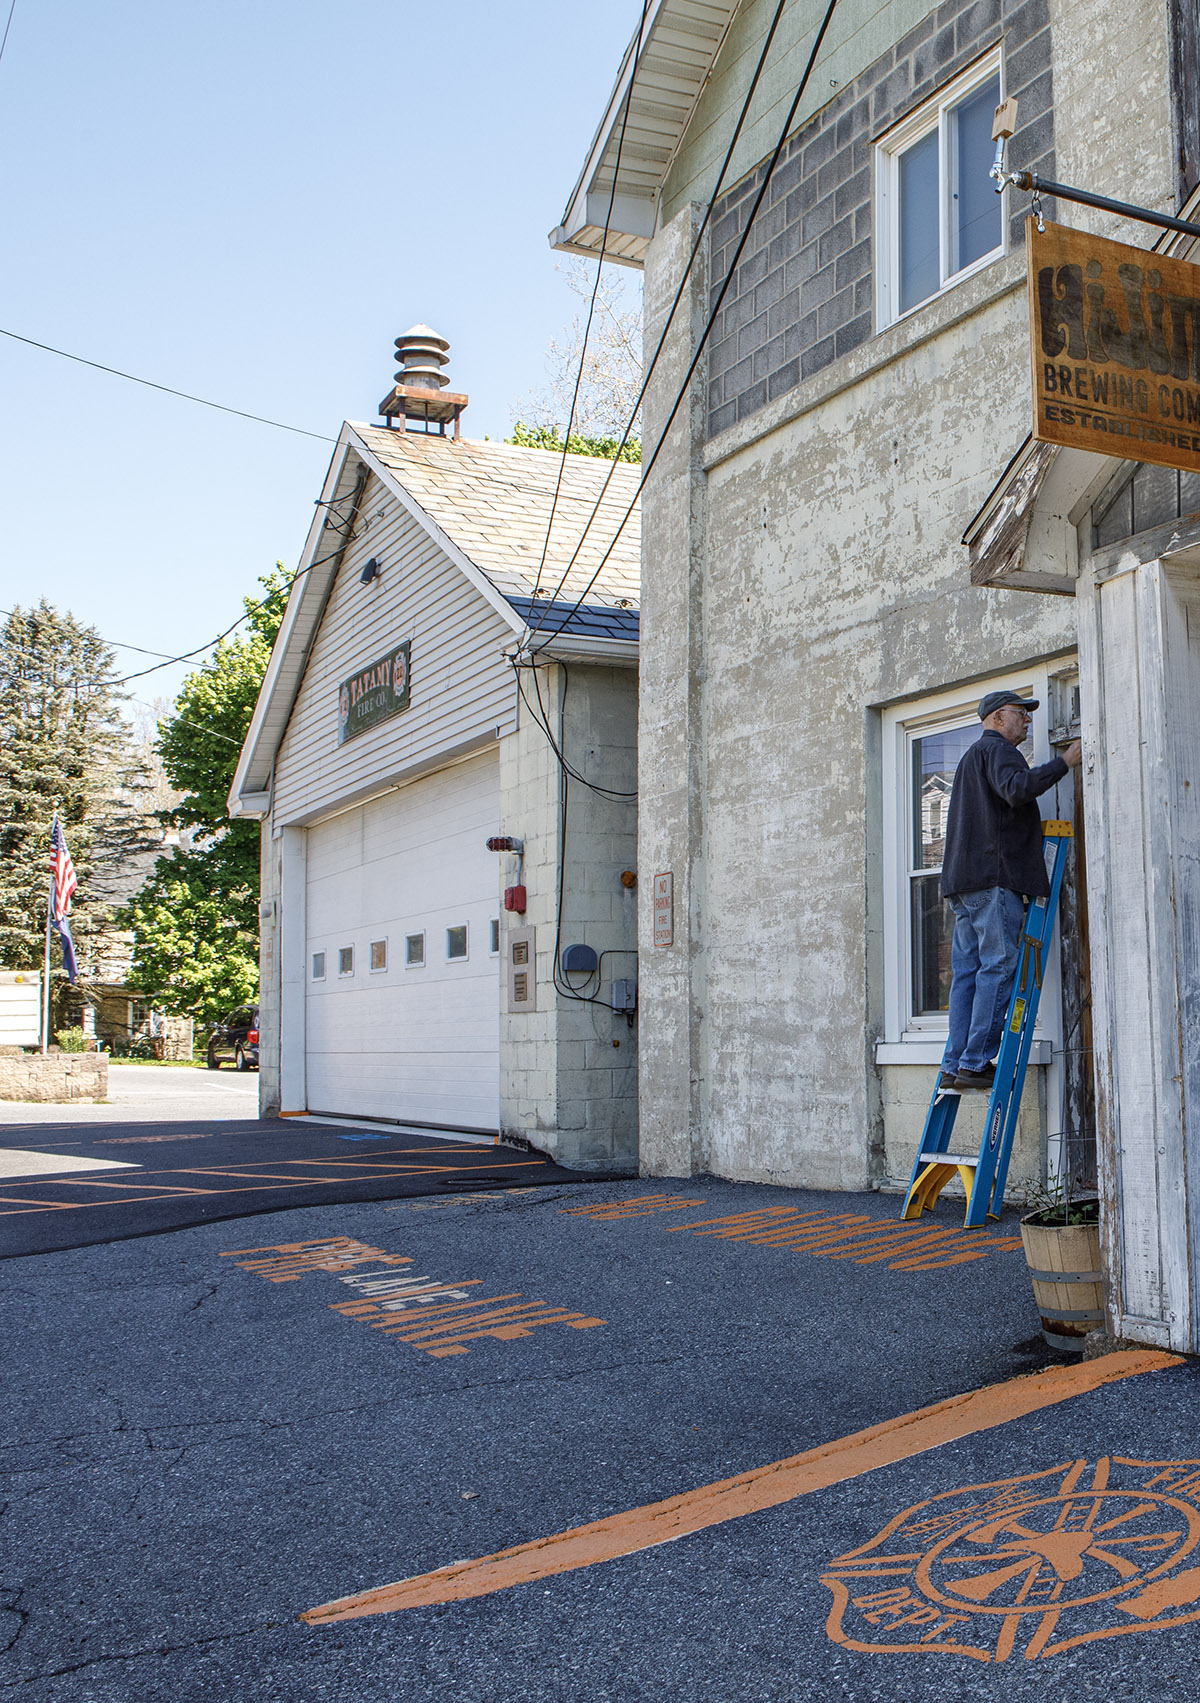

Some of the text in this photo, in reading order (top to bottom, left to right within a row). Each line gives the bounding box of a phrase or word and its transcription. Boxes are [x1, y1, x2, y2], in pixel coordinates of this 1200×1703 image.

[1044, 362, 1148, 415] BREWING
[351, 659, 392, 708] TATAMY
[357, 697, 375, 718] FIRE
[659, 879, 668, 894] NO
[655, 896, 671, 910] PARKING
[658, 914, 668, 925] FIRE
[655, 930, 671, 940] STATION
[326, 1279, 609, 1358] LANE
